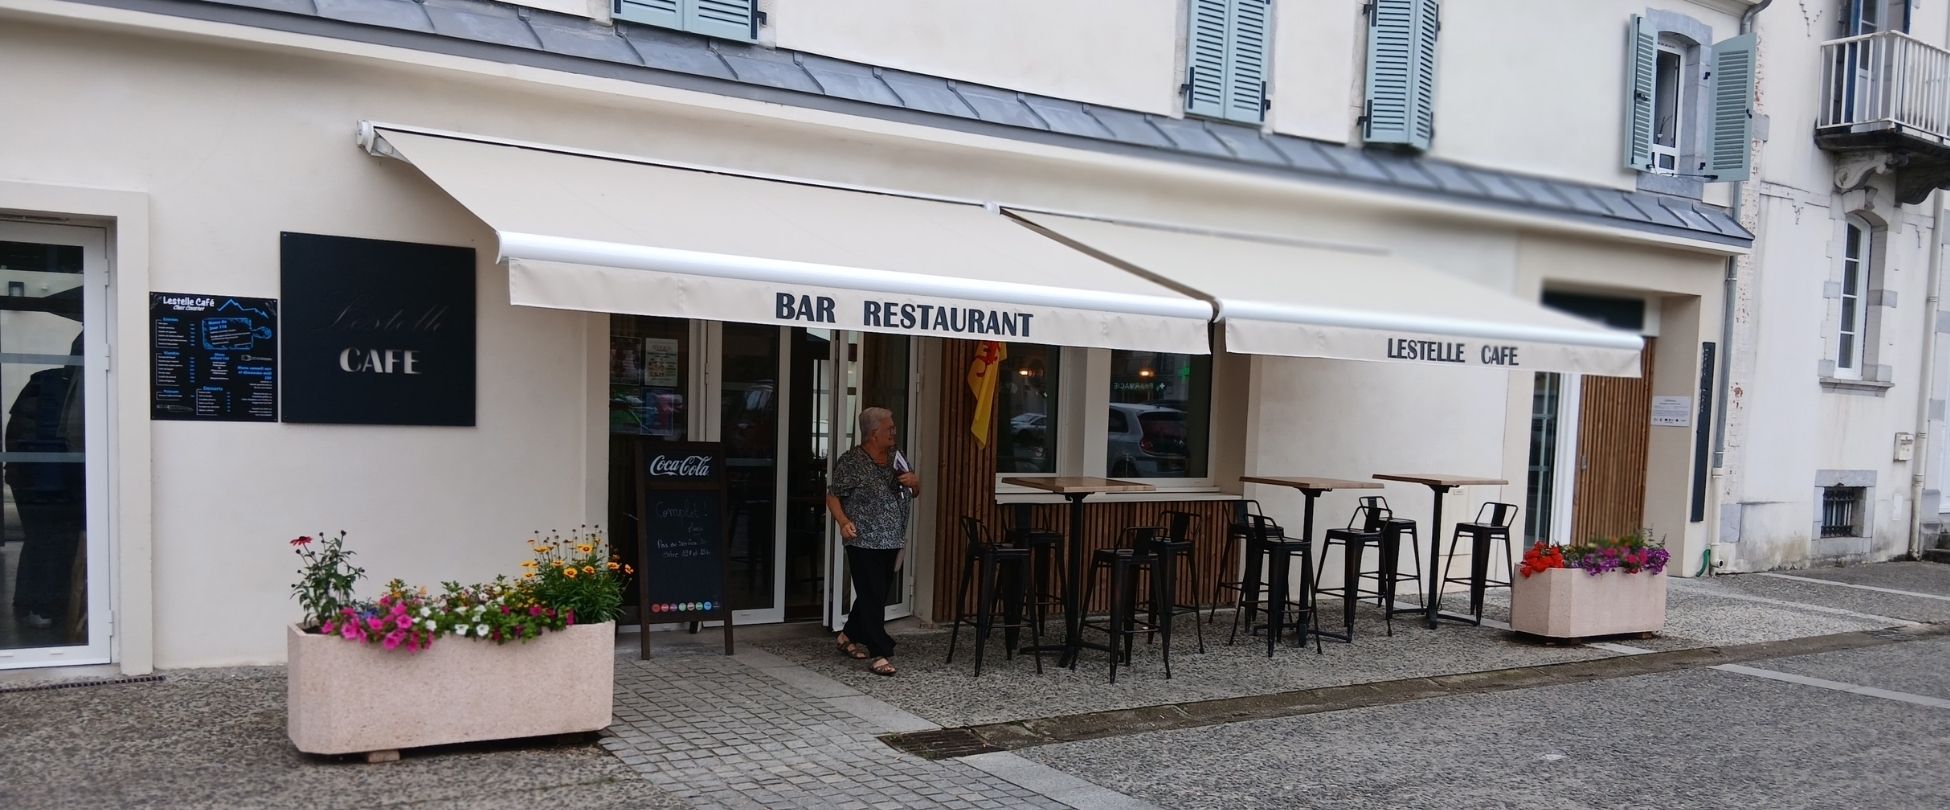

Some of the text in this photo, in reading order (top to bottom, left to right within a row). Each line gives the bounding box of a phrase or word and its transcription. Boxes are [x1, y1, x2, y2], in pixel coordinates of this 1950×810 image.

[163, 295, 215, 307] Lestelle Café
[775, 291, 1034, 338] BAR RESTAURANT
[339, 346, 423, 375] CAFE
[1387, 337, 1519, 366] LESTELLE CAFE
[650, 455, 712, 477] Coca-Cola
